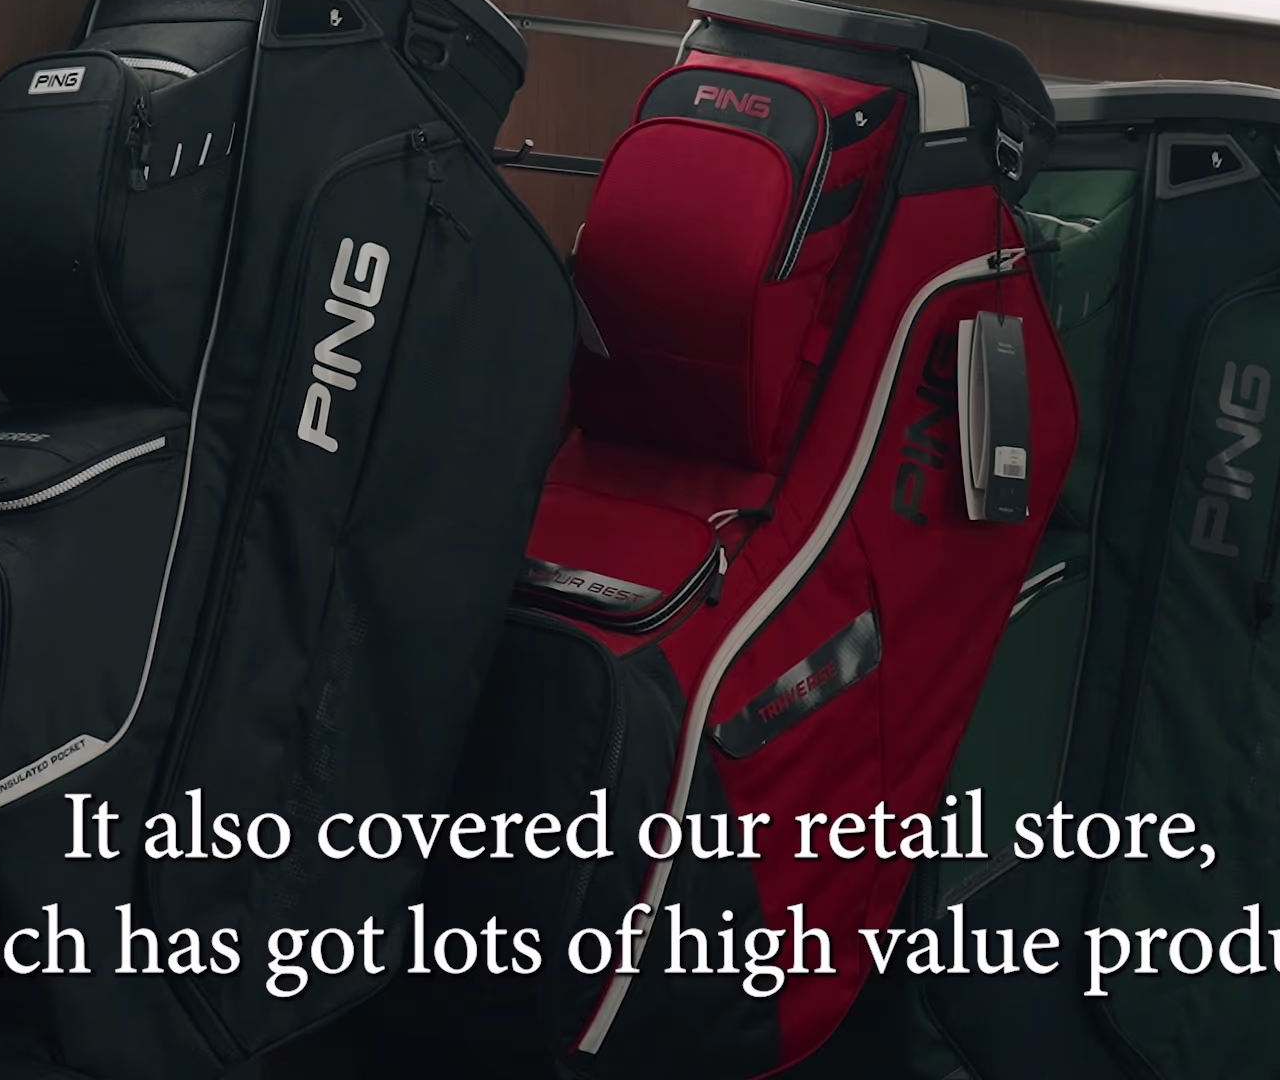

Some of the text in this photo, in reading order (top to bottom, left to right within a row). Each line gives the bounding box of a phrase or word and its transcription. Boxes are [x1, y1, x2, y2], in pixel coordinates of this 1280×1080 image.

[35, 71, 80, 90] PING
[693, 85, 772, 119] PING
[297, 237, 391, 453] PING
[1188, 360, 1272, 559] PING
[587, 582, 646, 603] BEST
[50, 739, 86, 765] POCKET
